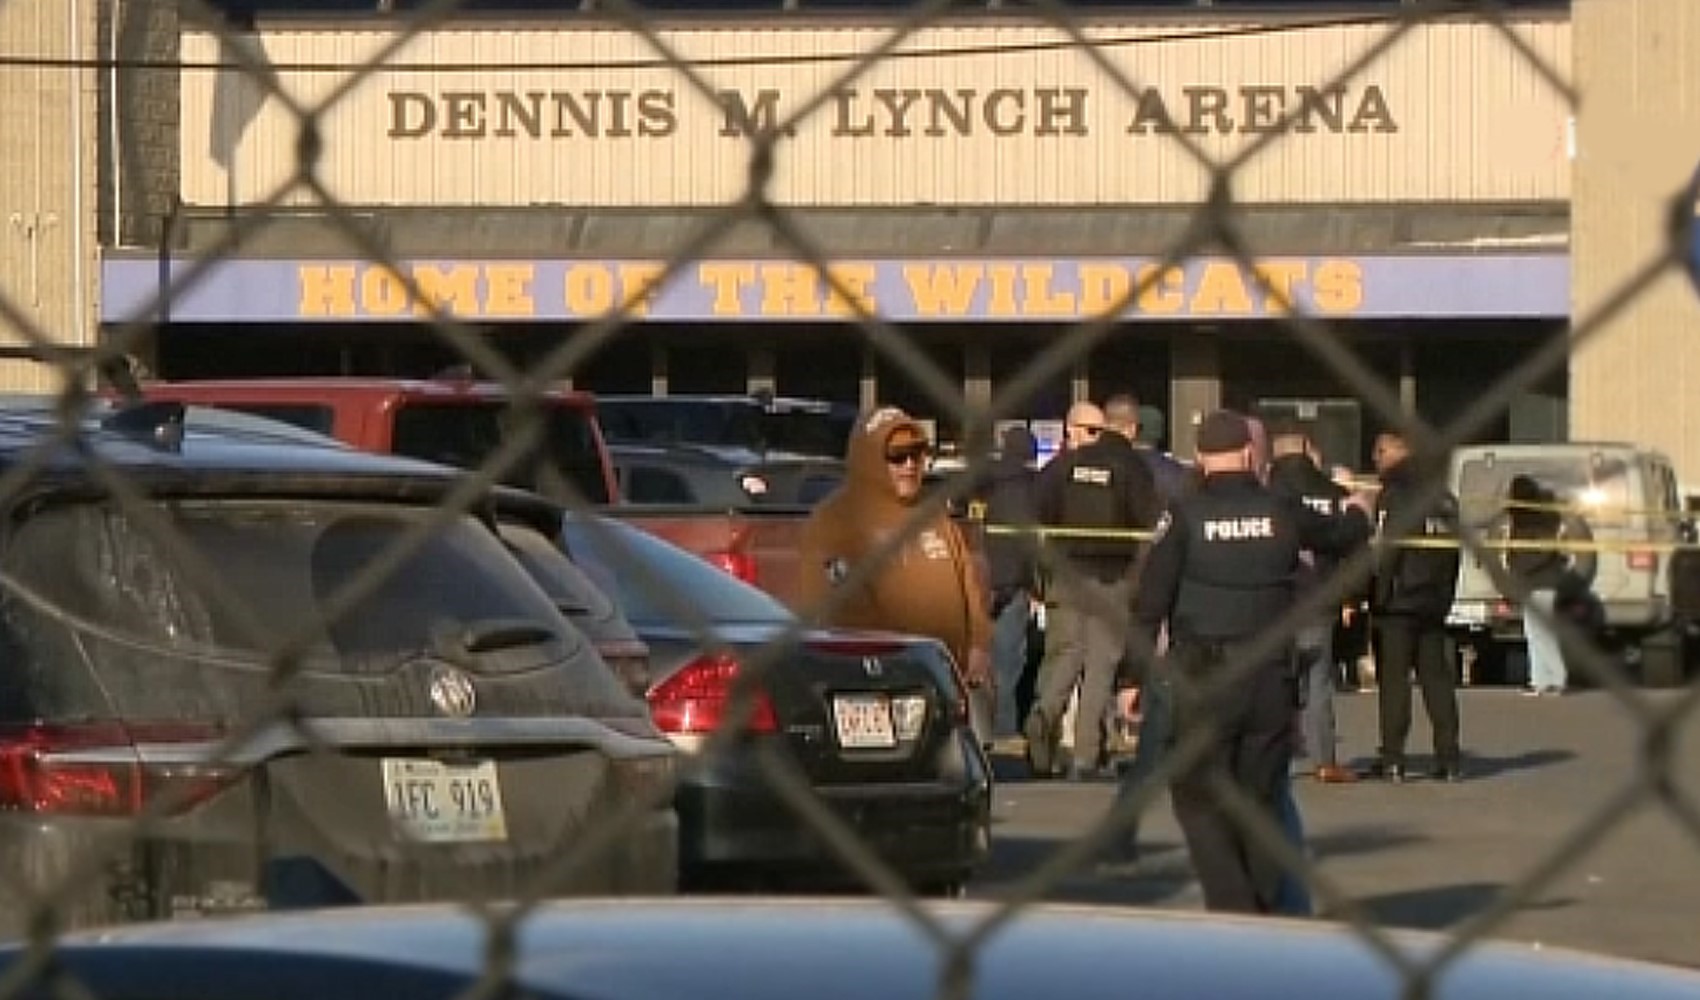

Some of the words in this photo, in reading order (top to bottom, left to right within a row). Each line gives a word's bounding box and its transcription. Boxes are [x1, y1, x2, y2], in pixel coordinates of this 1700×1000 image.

[387, 91, 677, 138] DENNIS
[719, 88, 797, 138] M.
[832, 88, 1089, 136] LYNCH
[1126, 85, 1398, 134] ARENA
[298, 264, 534, 316] HOME
[564, 264, 660, 316] OF
[699, 264, 877, 315] THE
[902, 260, 1363, 315] WILDCATS
[1203, 516, 1274, 541] POLICE
